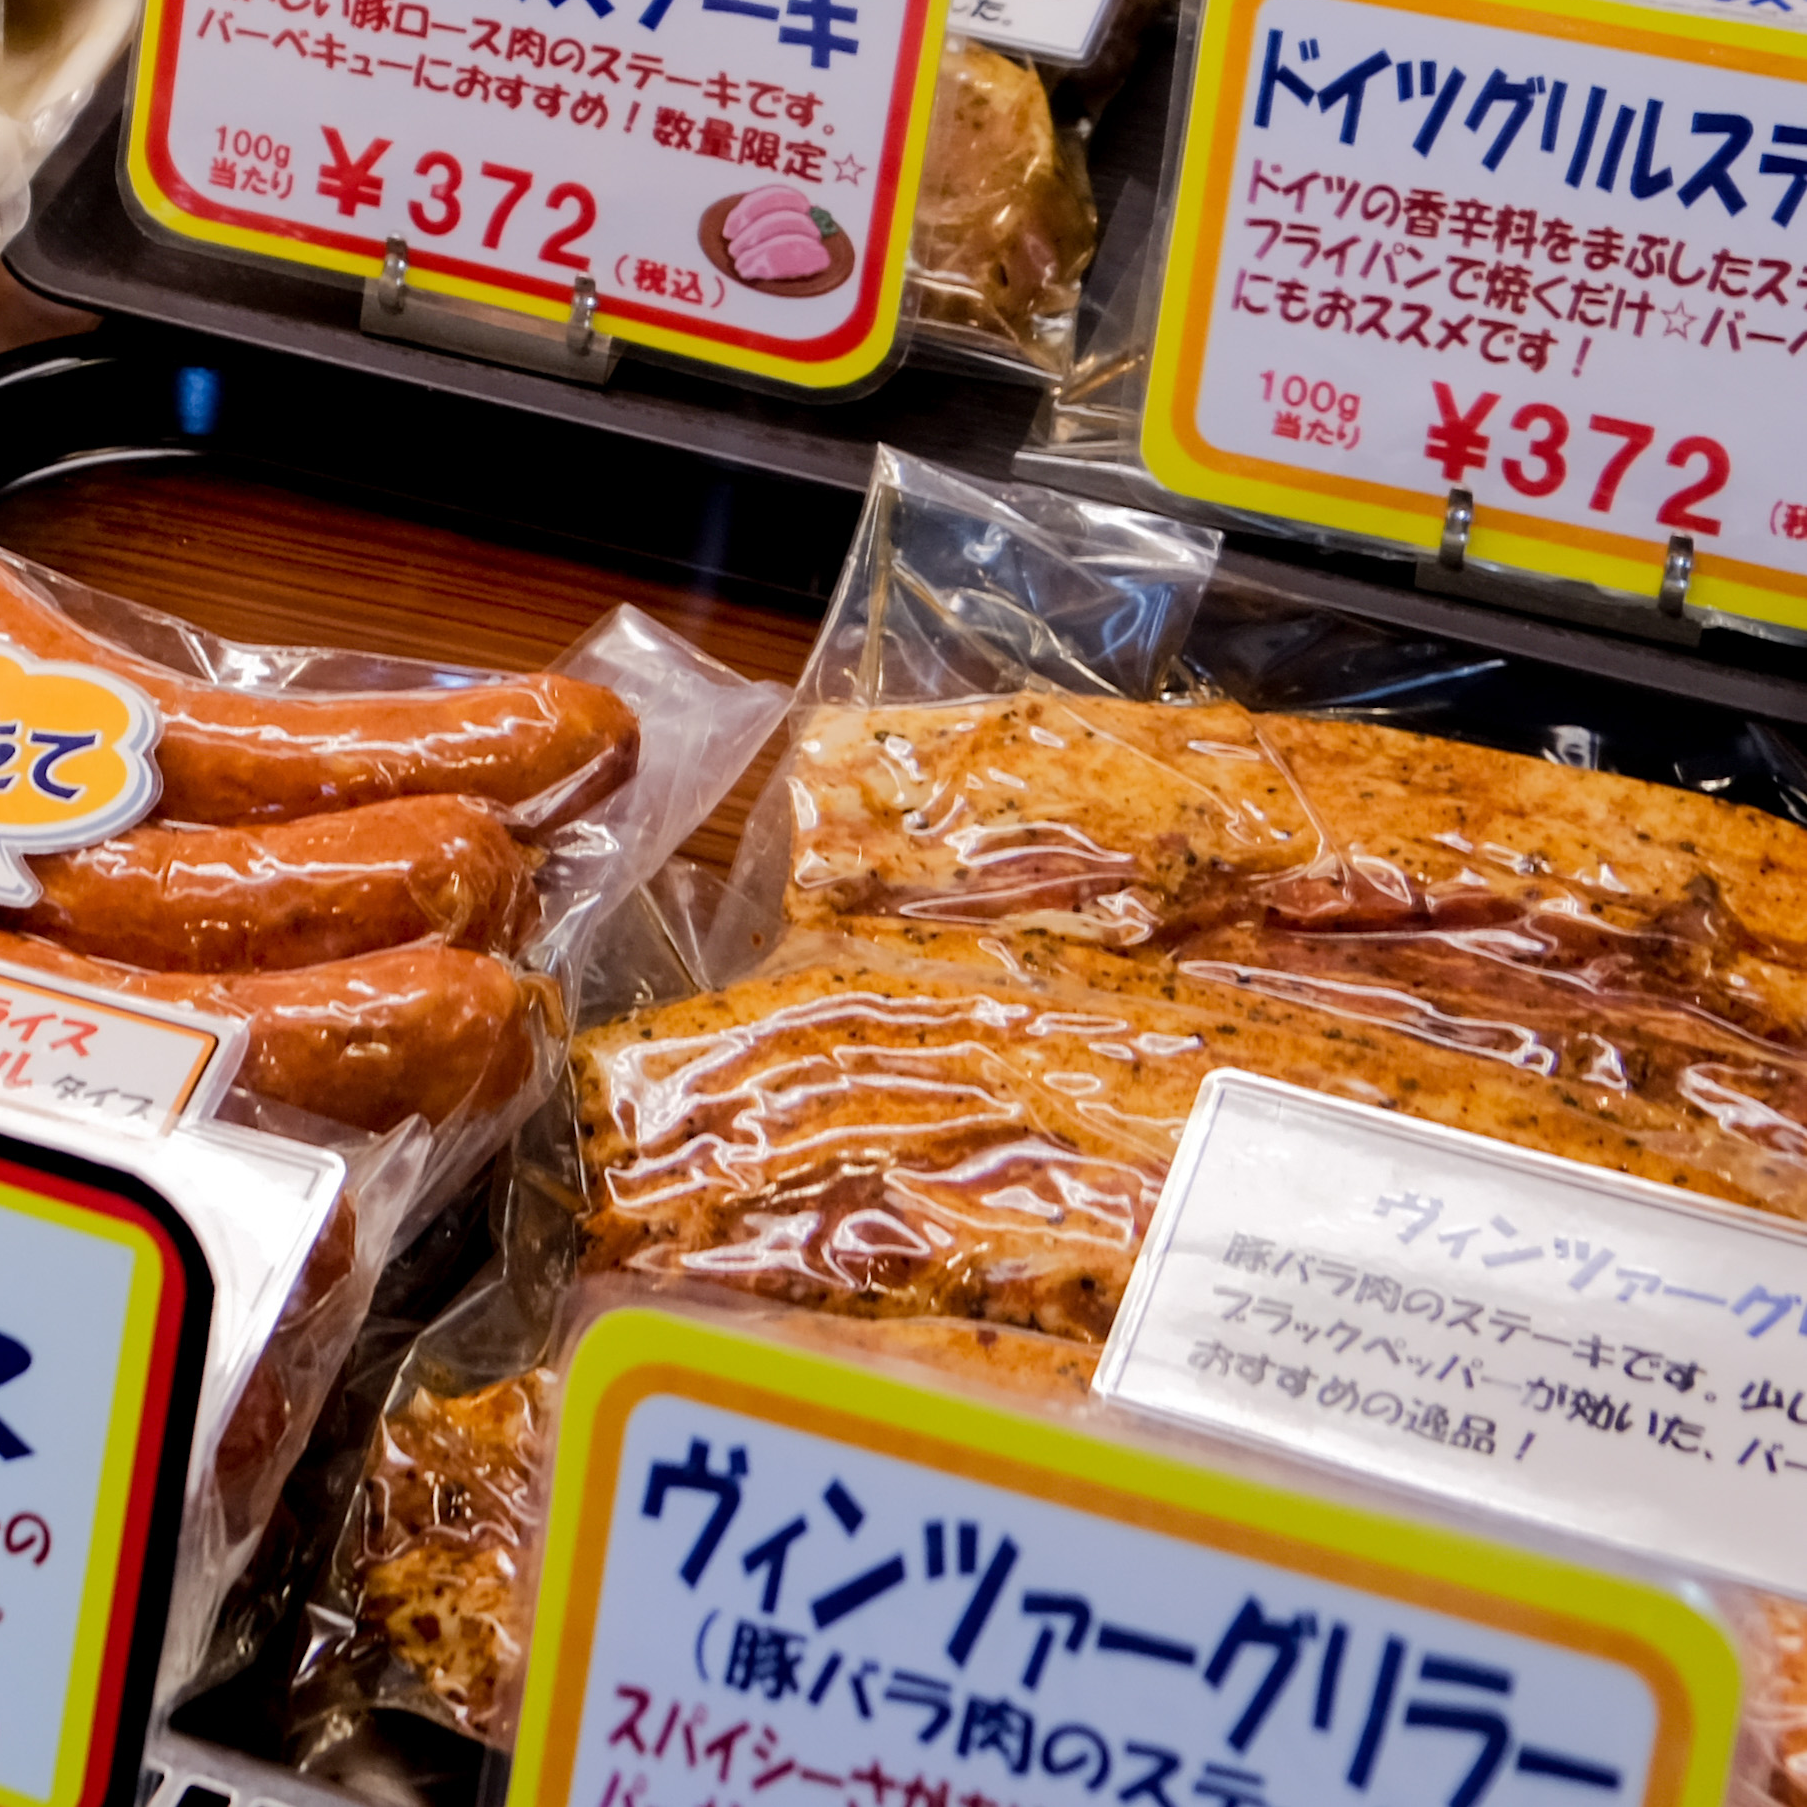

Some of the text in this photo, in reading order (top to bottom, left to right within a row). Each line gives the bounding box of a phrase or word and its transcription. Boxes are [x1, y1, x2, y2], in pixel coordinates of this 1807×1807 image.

[206, 156, 297, 204] 当たり
[212, 123, 734, 315] 100g ¥372 (税込)
[1258, 368, 1362, 420] 100g
[1424, 380, 1733, 538] ¥372
[1269, 410, 1362, 452] 当たり
[639, 1434, 1623, 1807] ヴィンツァーグリラー
